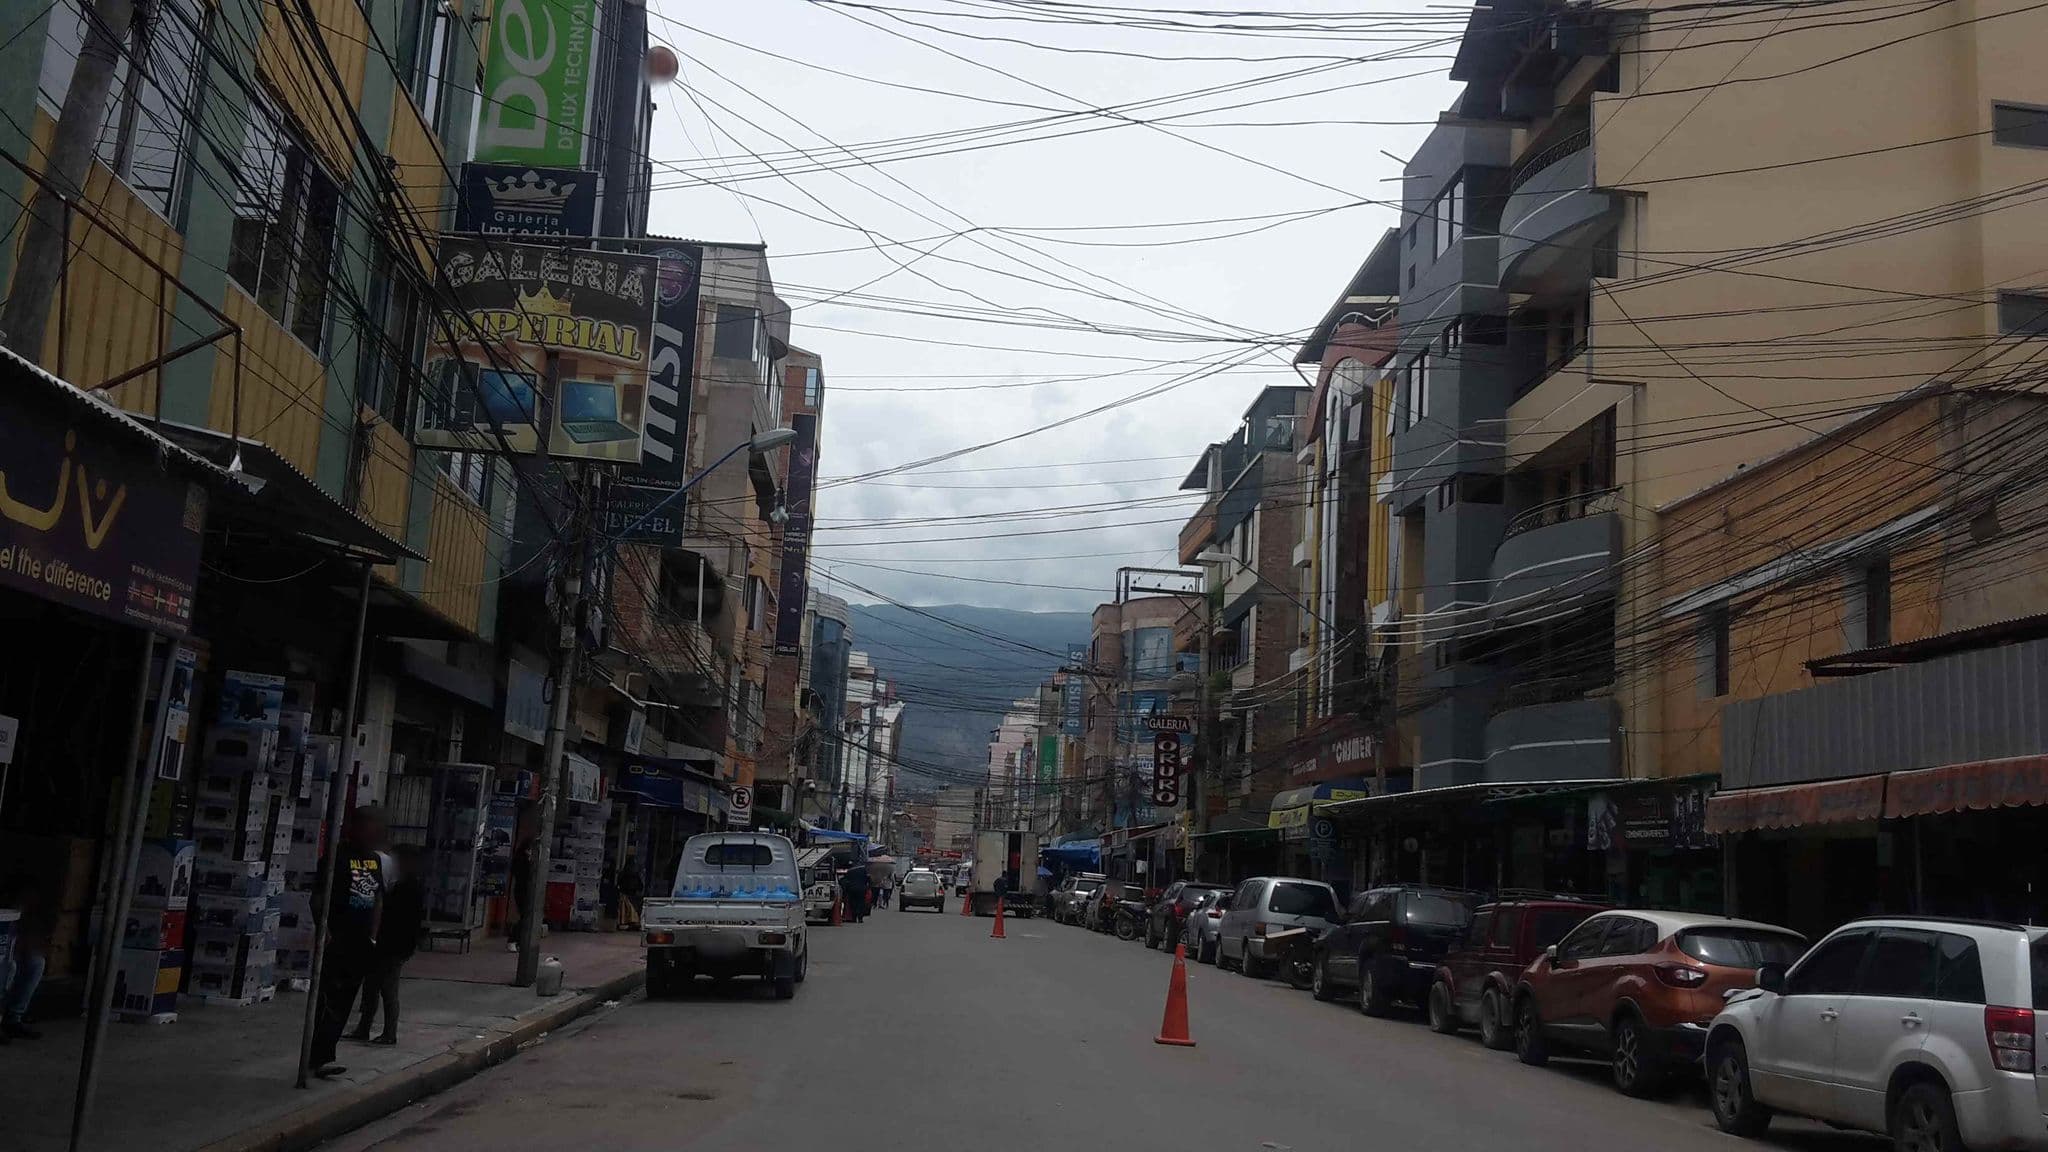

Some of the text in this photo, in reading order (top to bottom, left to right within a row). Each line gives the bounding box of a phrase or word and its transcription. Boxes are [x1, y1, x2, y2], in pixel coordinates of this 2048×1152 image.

[557, 92, 579, 150] DELUX
[494, 211, 560, 226] Galeria
[442, 247, 645, 305] GALERIA
[433, 310, 642, 361] IMPERIAL
[17, 547, 42, 579] the
[44, 558, 112, 601] difference
[1149, 717, 1188, 730] GALERIA
[1156, 739, 1178, 802] ORURO
